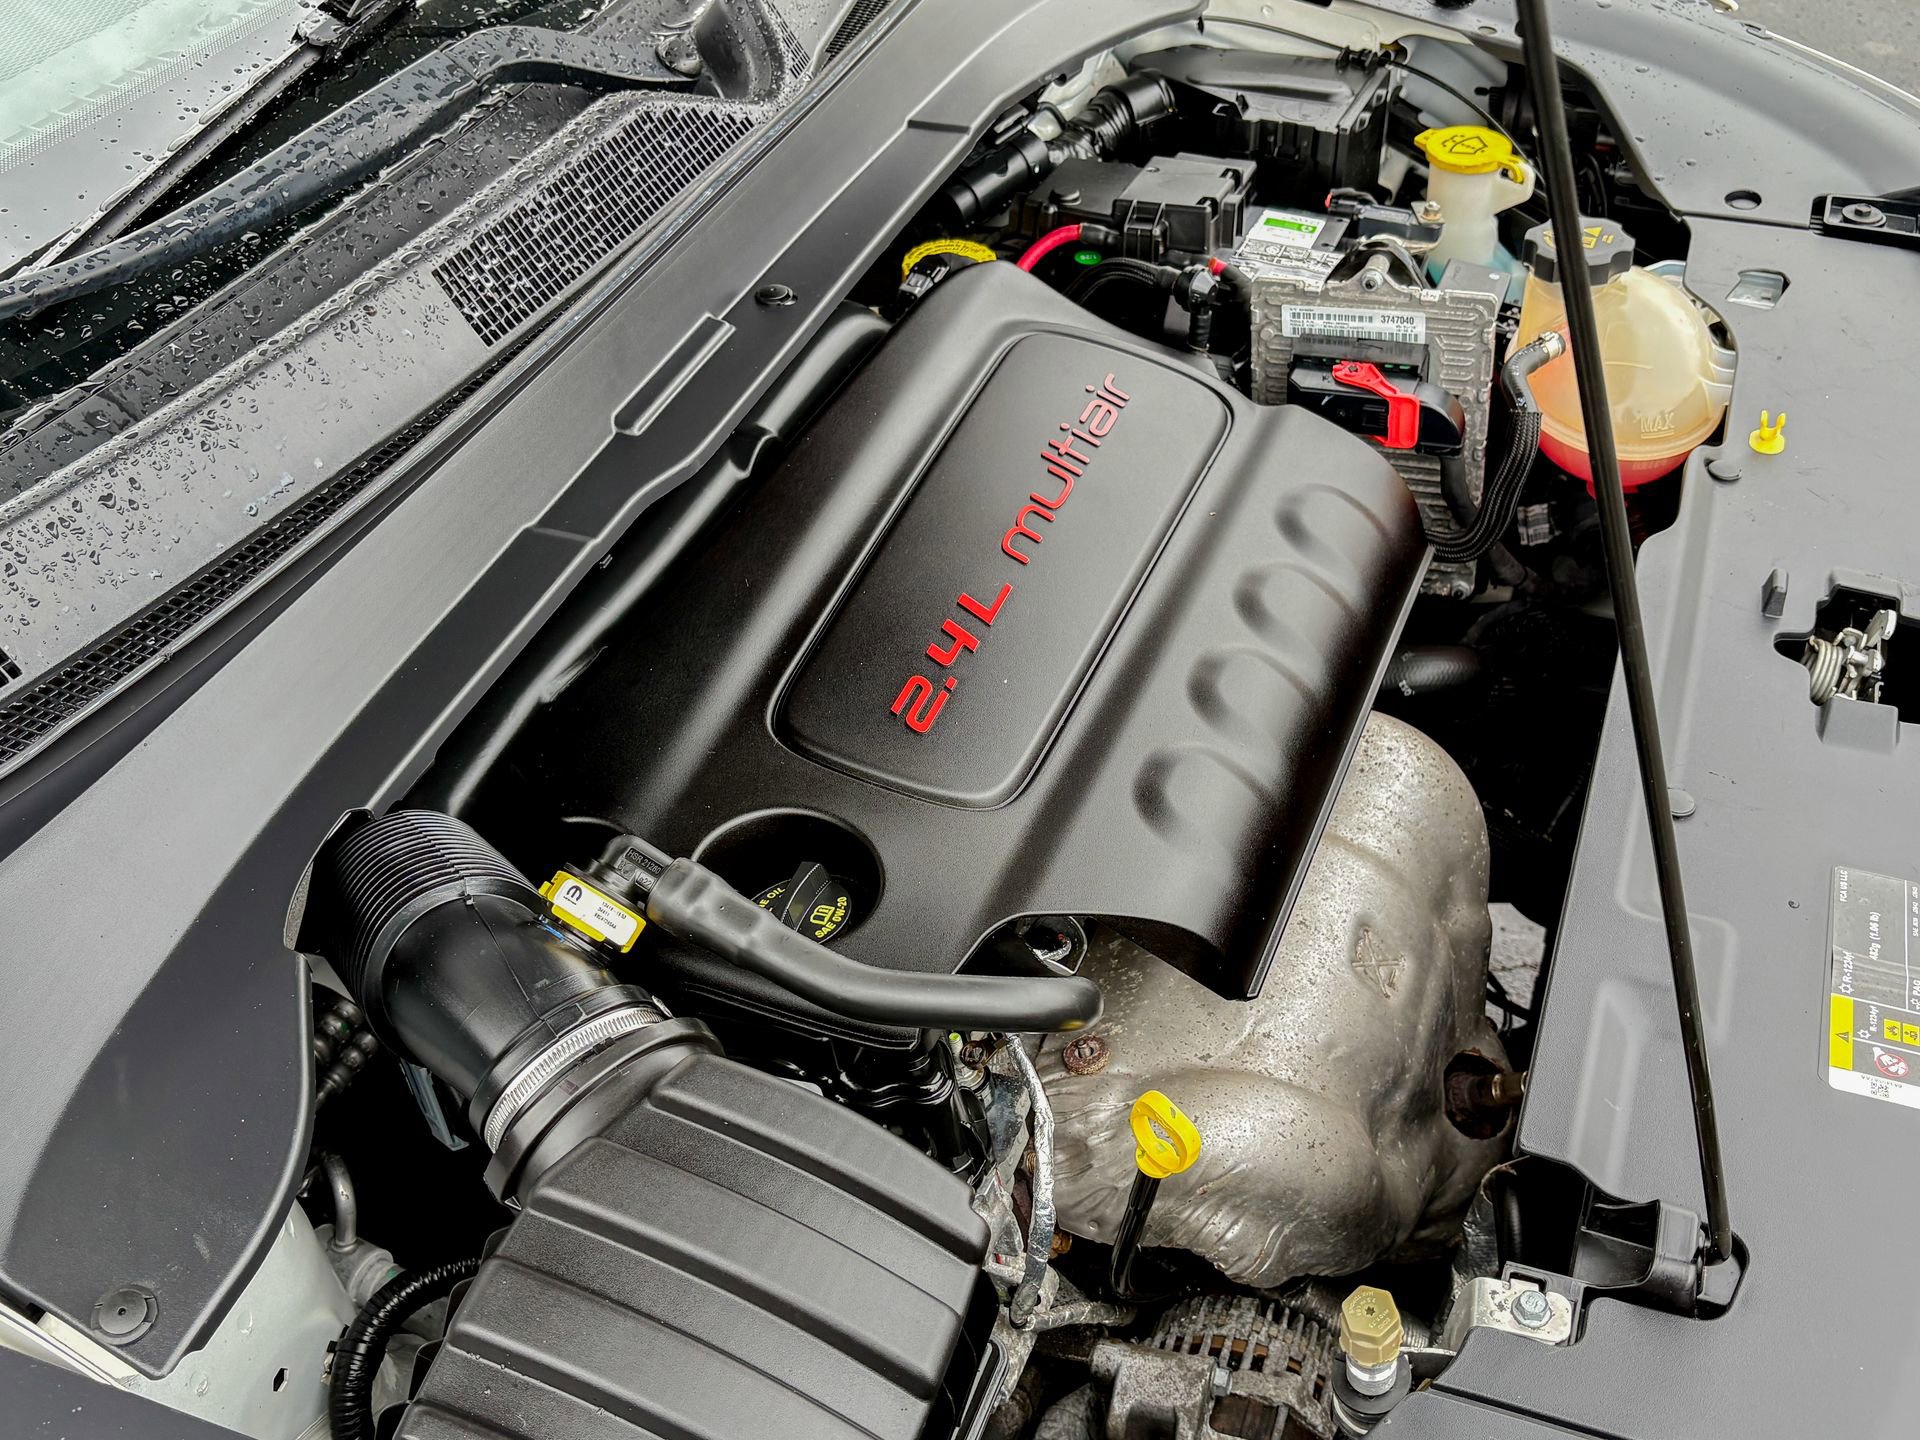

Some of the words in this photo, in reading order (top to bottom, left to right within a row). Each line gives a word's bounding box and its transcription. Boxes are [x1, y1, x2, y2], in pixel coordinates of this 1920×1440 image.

[1381, 315, 1415, 325] 3747040
[1640, 412, 1675, 433] MAX
[1002, 373, 1130, 565] multiair
[890, 583, 1013, 734] 2.4L
[1840, 870, 1848, 881] LLC
[767, 888, 786, 899] OIL
[1840, 891, 1848, 902] FCA
[815, 922, 836, 938] SAE
[832, 897, 847, 922] 0W-20
[1842, 951, 1855, 983] R-1234yf
